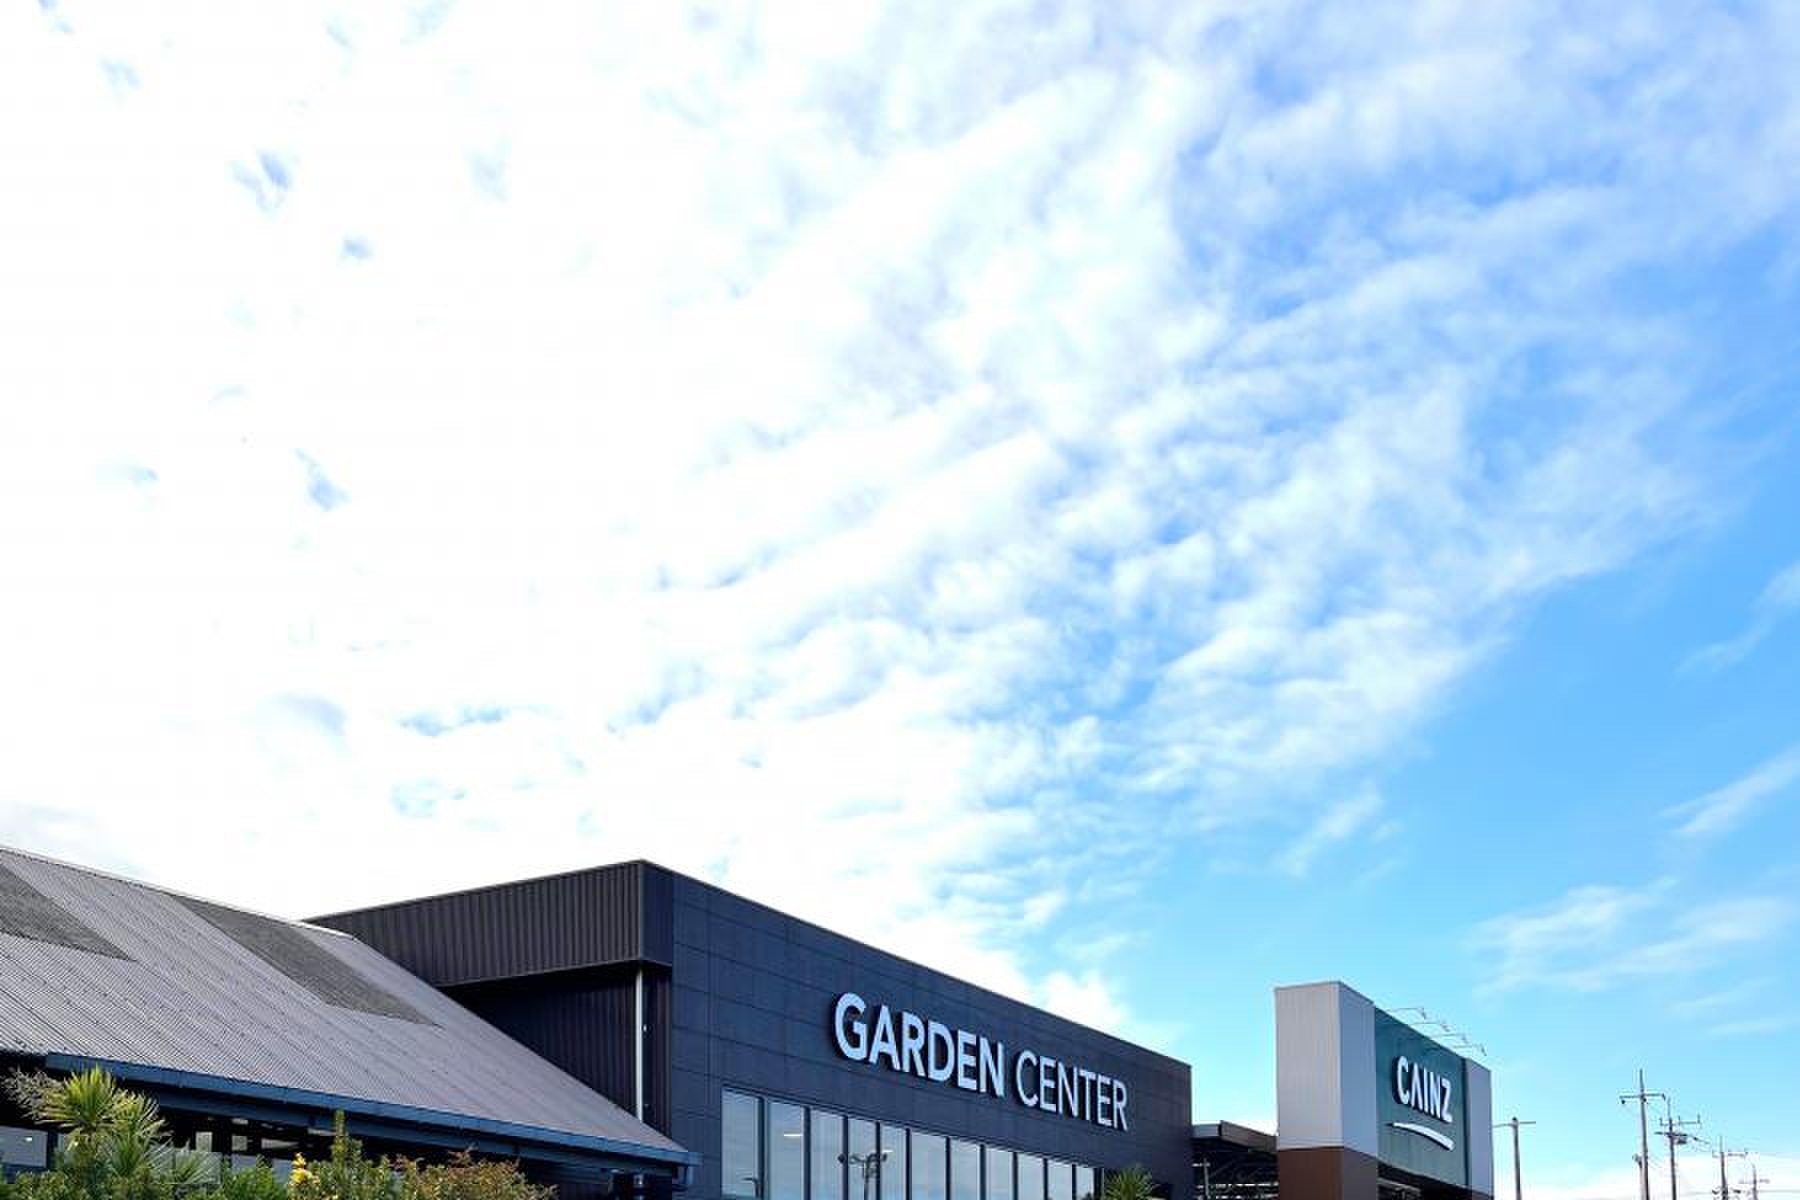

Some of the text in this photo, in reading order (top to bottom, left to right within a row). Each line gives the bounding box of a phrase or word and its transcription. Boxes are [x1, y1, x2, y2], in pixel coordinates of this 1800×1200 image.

[833, 991, 1130, 1132] GARDEN CENTER
[1396, 1055, 1453, 1123] CAINZ
